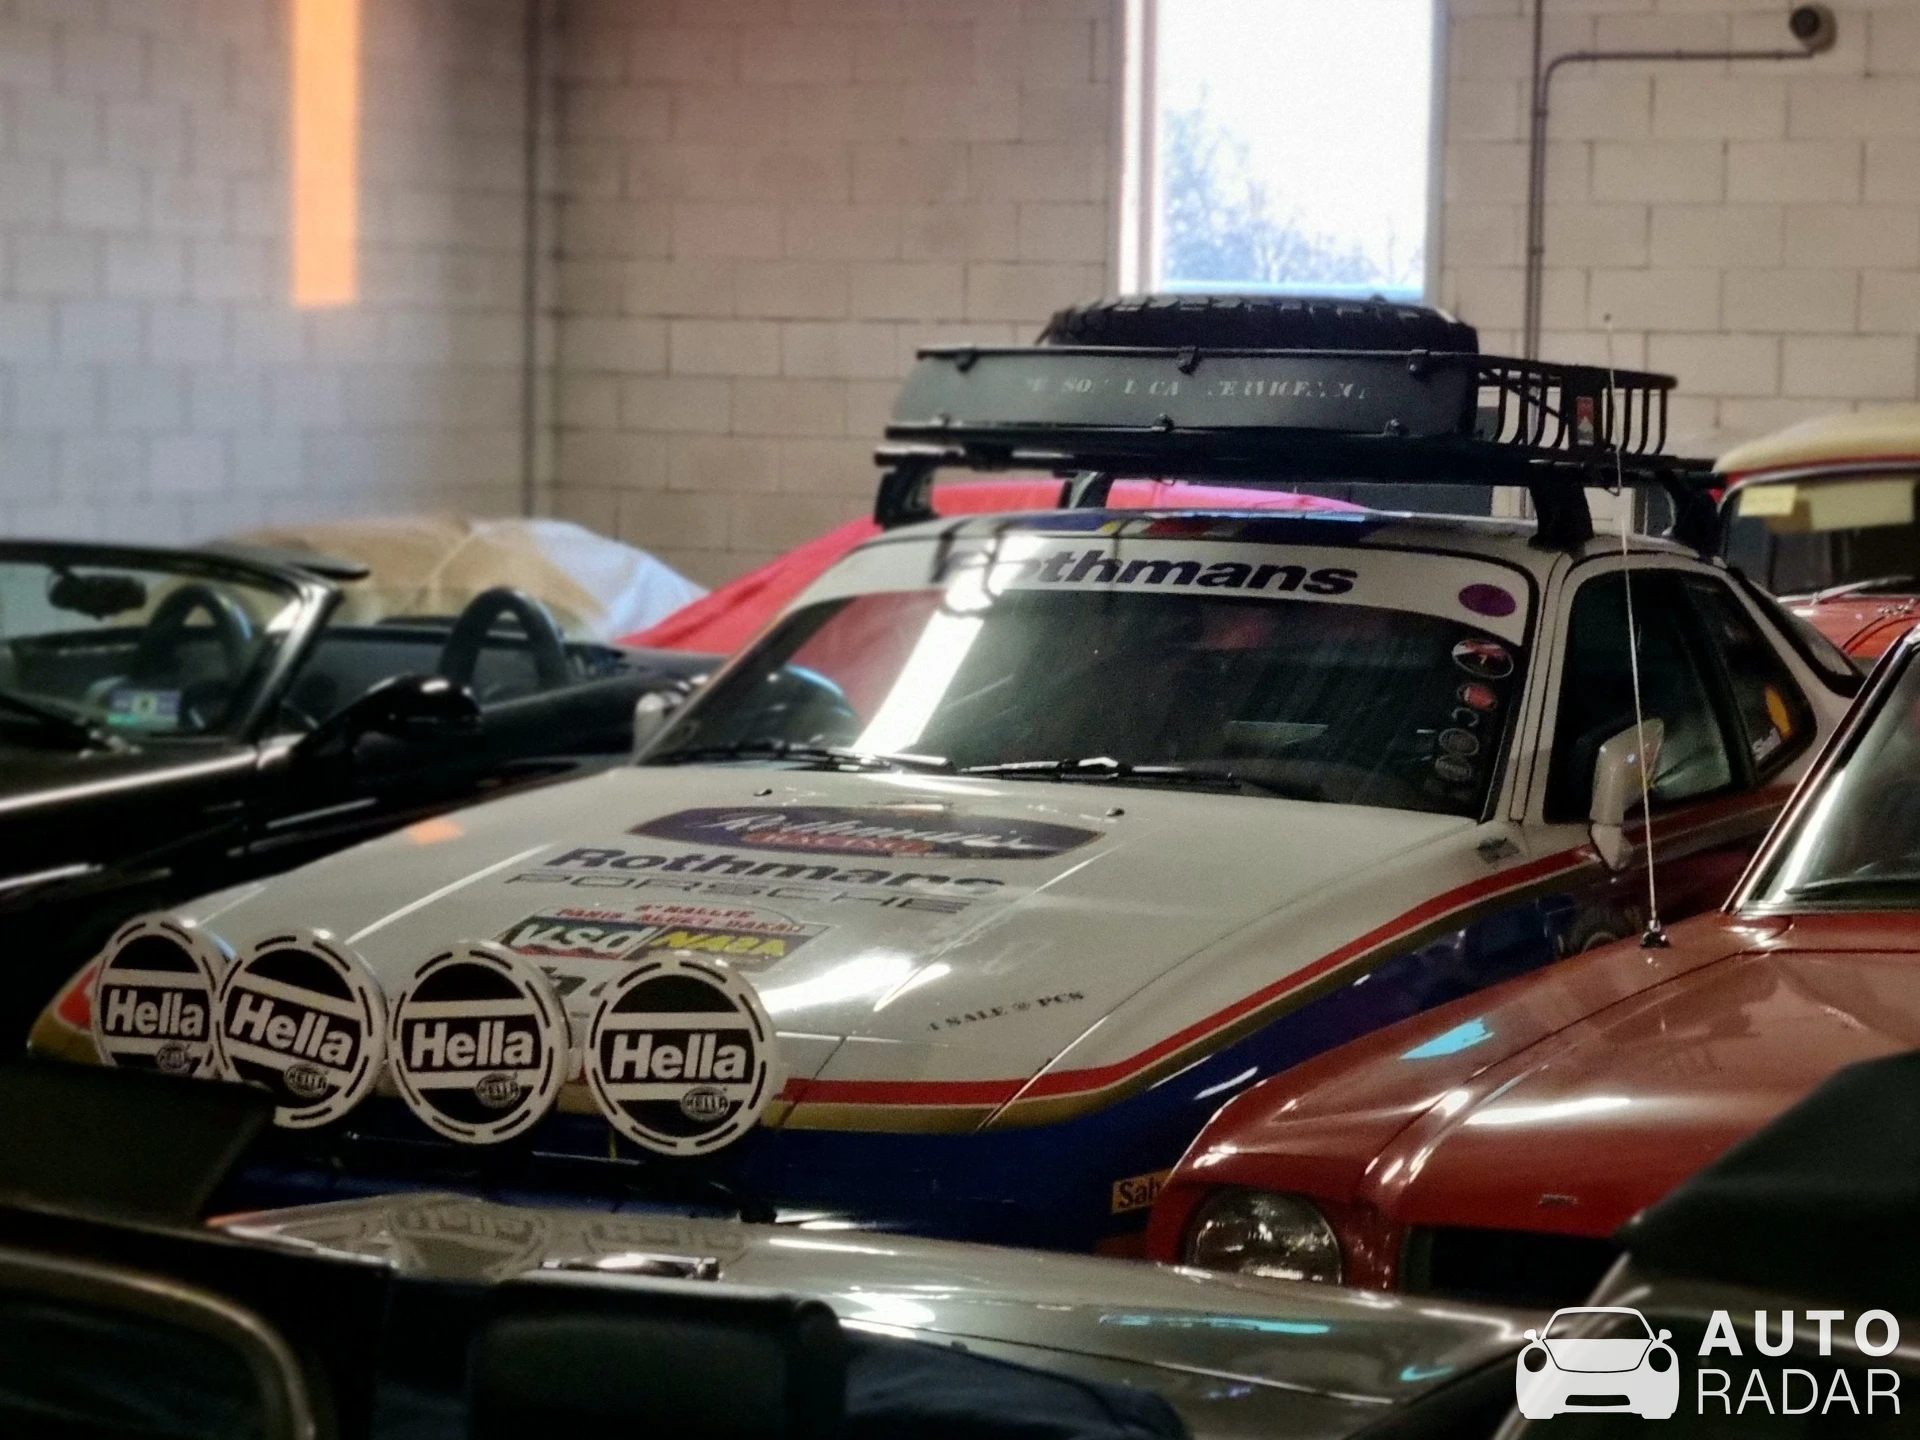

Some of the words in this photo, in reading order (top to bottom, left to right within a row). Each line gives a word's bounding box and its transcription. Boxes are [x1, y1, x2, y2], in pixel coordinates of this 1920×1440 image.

[504, 873, 979, 914] PORSCHE
[104, 988, 206, 1039] Hella
[229, 994, 354, 1066] Hella
[410, 1020, 535, 1068] Hella
[609, 1032, 748, 1081] Hella
